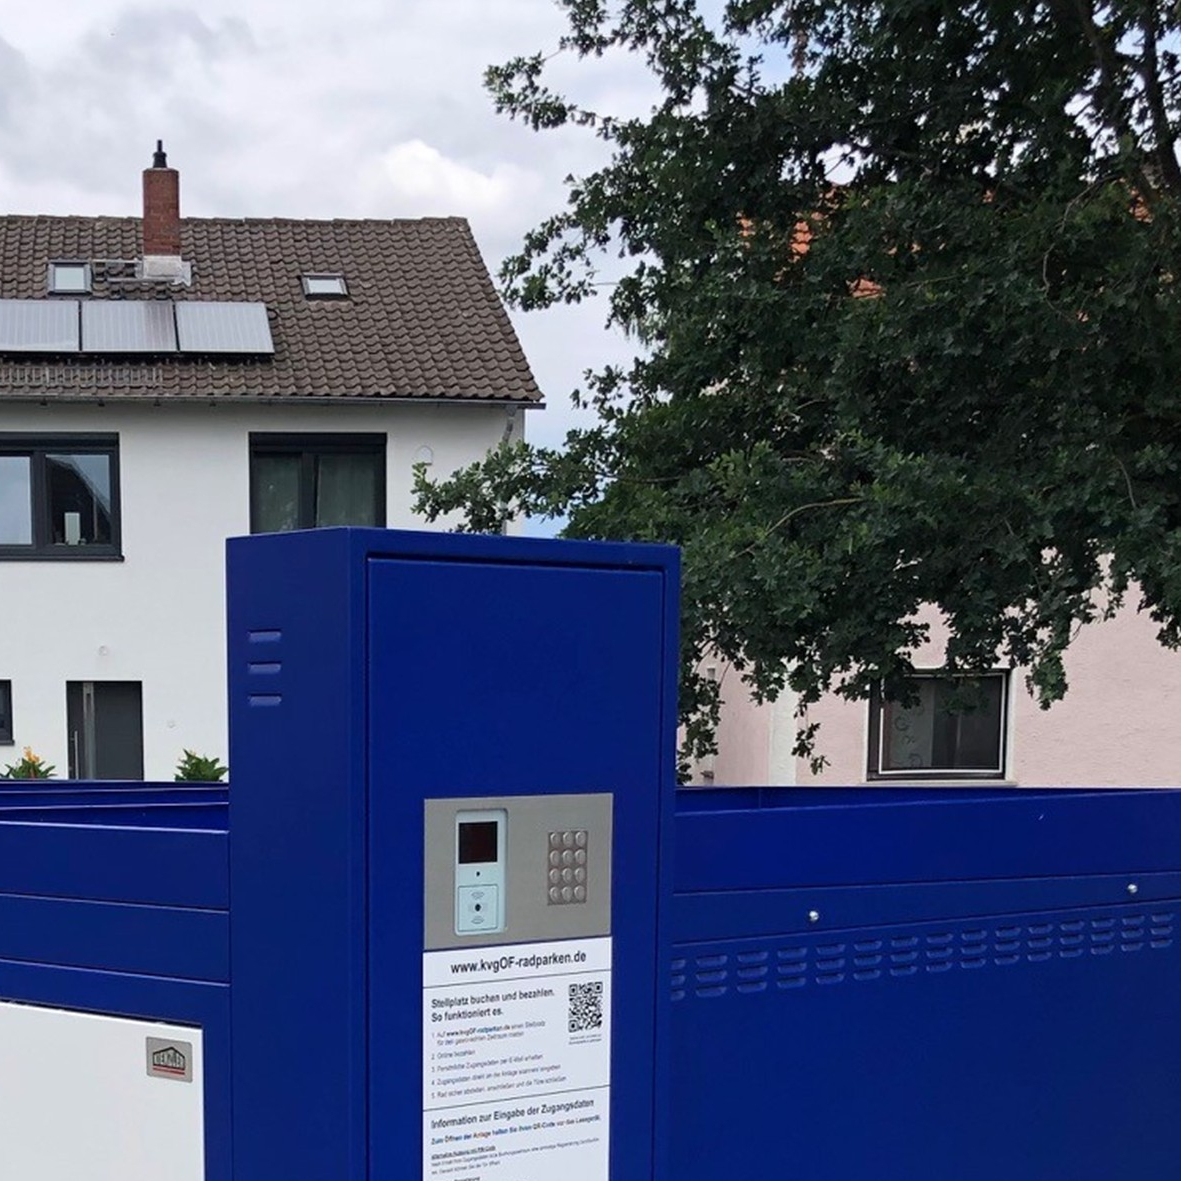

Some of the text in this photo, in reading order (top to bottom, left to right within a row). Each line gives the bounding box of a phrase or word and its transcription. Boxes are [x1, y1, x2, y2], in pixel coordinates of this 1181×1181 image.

[450, 950, 587, 973] www.kvgOF-radparken.de
[431, 986, 554, 1011] Stellplatz buchen und bezahlen.
[444, 1007, 490, 1021] funktioniert
[492, 1007, 503, 1016] es.
[431, 1097, 594, 1128] Information zur Eingabe der Zugangsdaten
